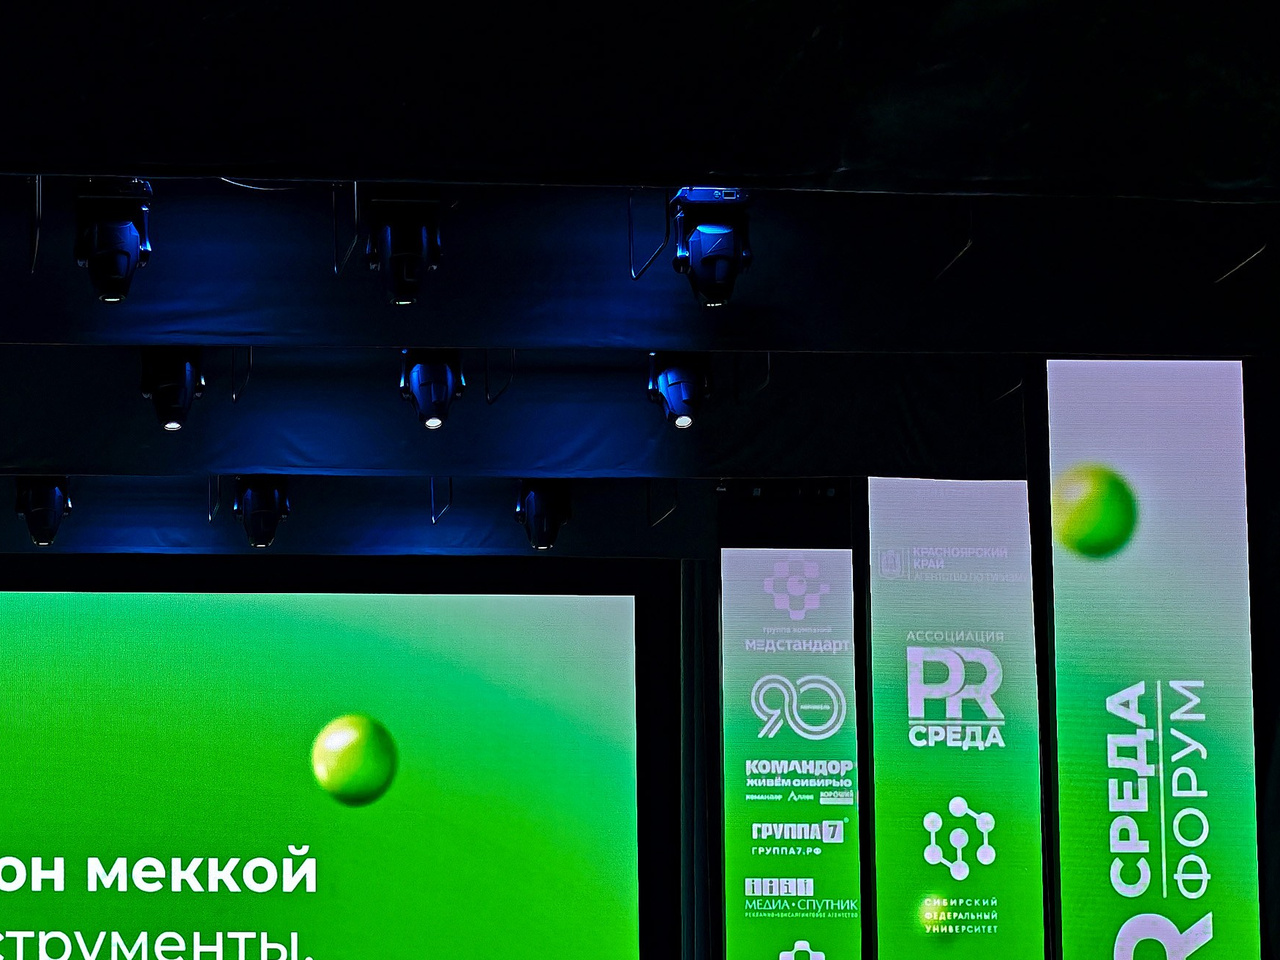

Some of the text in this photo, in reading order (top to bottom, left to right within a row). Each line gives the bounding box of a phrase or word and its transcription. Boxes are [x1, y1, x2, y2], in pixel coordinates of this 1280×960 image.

[906, 631, 1004, 643] АССОЦИАЦИЯ
[906, 646, 1005, 719] PR
[908, 726, 1006, 751] СРЕДА
[746, 760, 853, 776] КОМАНДОР
[746, 777, 852, 787] ЖИВЁМ СИБИРЬЮ
[1105, 680, 1155, 898] СРЕДА
[1168, 680, 1211, 899] ФОРУМ
[751, 846, 822, 855] ГРУППА7.РФ
[87, 845, 317, 893] меккой
[924, 896, 998, 906] СИБИРСКИЙ
[924, 910, 998, 920] ФЕДЕРАЛЬНЫЙ
[925, 925, 998, 933] УНИВЕРСИТЕТ
